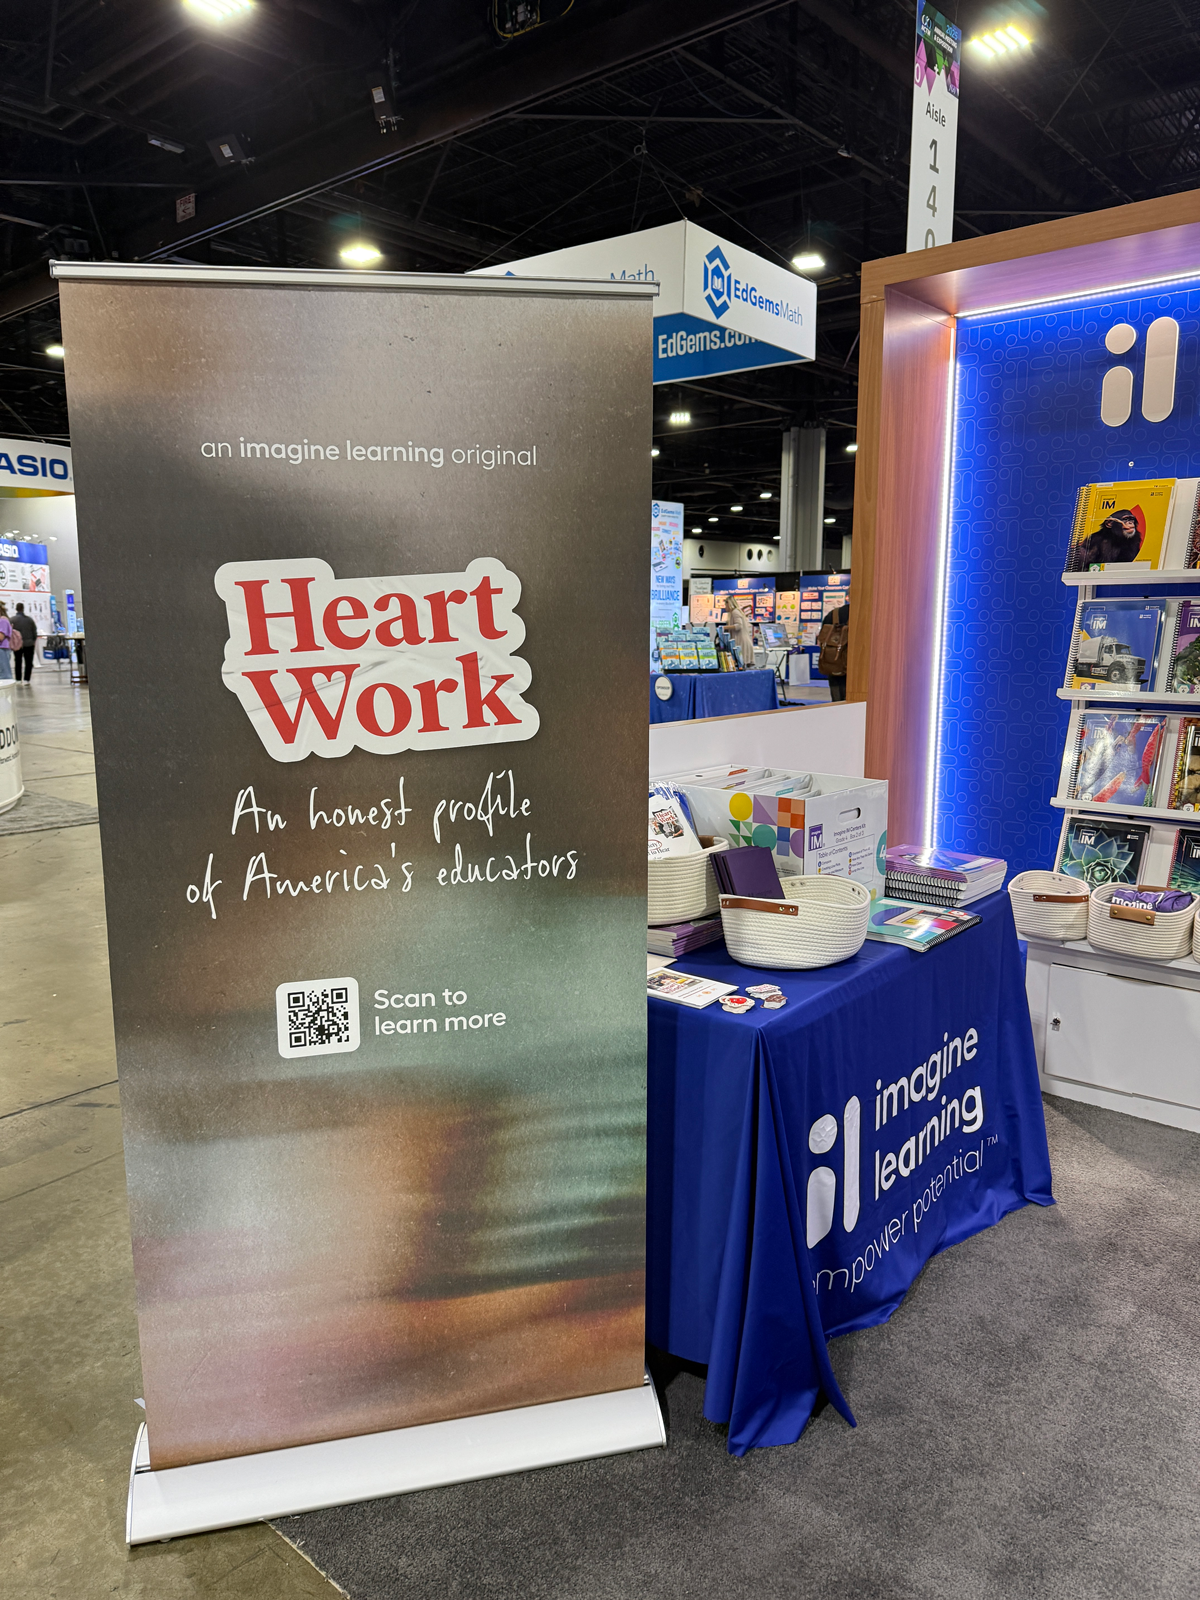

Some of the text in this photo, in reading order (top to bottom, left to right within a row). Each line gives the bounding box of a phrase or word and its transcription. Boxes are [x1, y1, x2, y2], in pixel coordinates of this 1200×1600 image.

[946, 24, 958, 40] 2025
[926, 101, 946, 127] Aisle
[658, 329, 761, 358] EdGems.co
[0, 452, 69, 480] ASIO
[200, 436, 536, 470] an imagine learning original
[1102, 501, 1115, 509] IM
[0, 544, 19, 558] ASIO
[234, 576, 508, 656] Heart
[1092, 621, 1106, 630] IM
[241, 651, 522, 744] Work
[231, 770, 532, 843] An honest profile
[656, 810, 672, 818] Heart
[811, 834, 822, 849] IM
[1081, 835, 1095, 845] IM
[186, 832, 579, 919] of America's educators
[1112, 896, 1153, 909] maine
[374, 988, 467, 1010] Scan to
[375, 1012, 507, 1035] learn more
[875, 1027, 978, 1131] imagine
[875, 1085, 984, 1201] learning
[813, 1210, 909, 1294] mpower
[913, 1139, 984, 1233] potential
